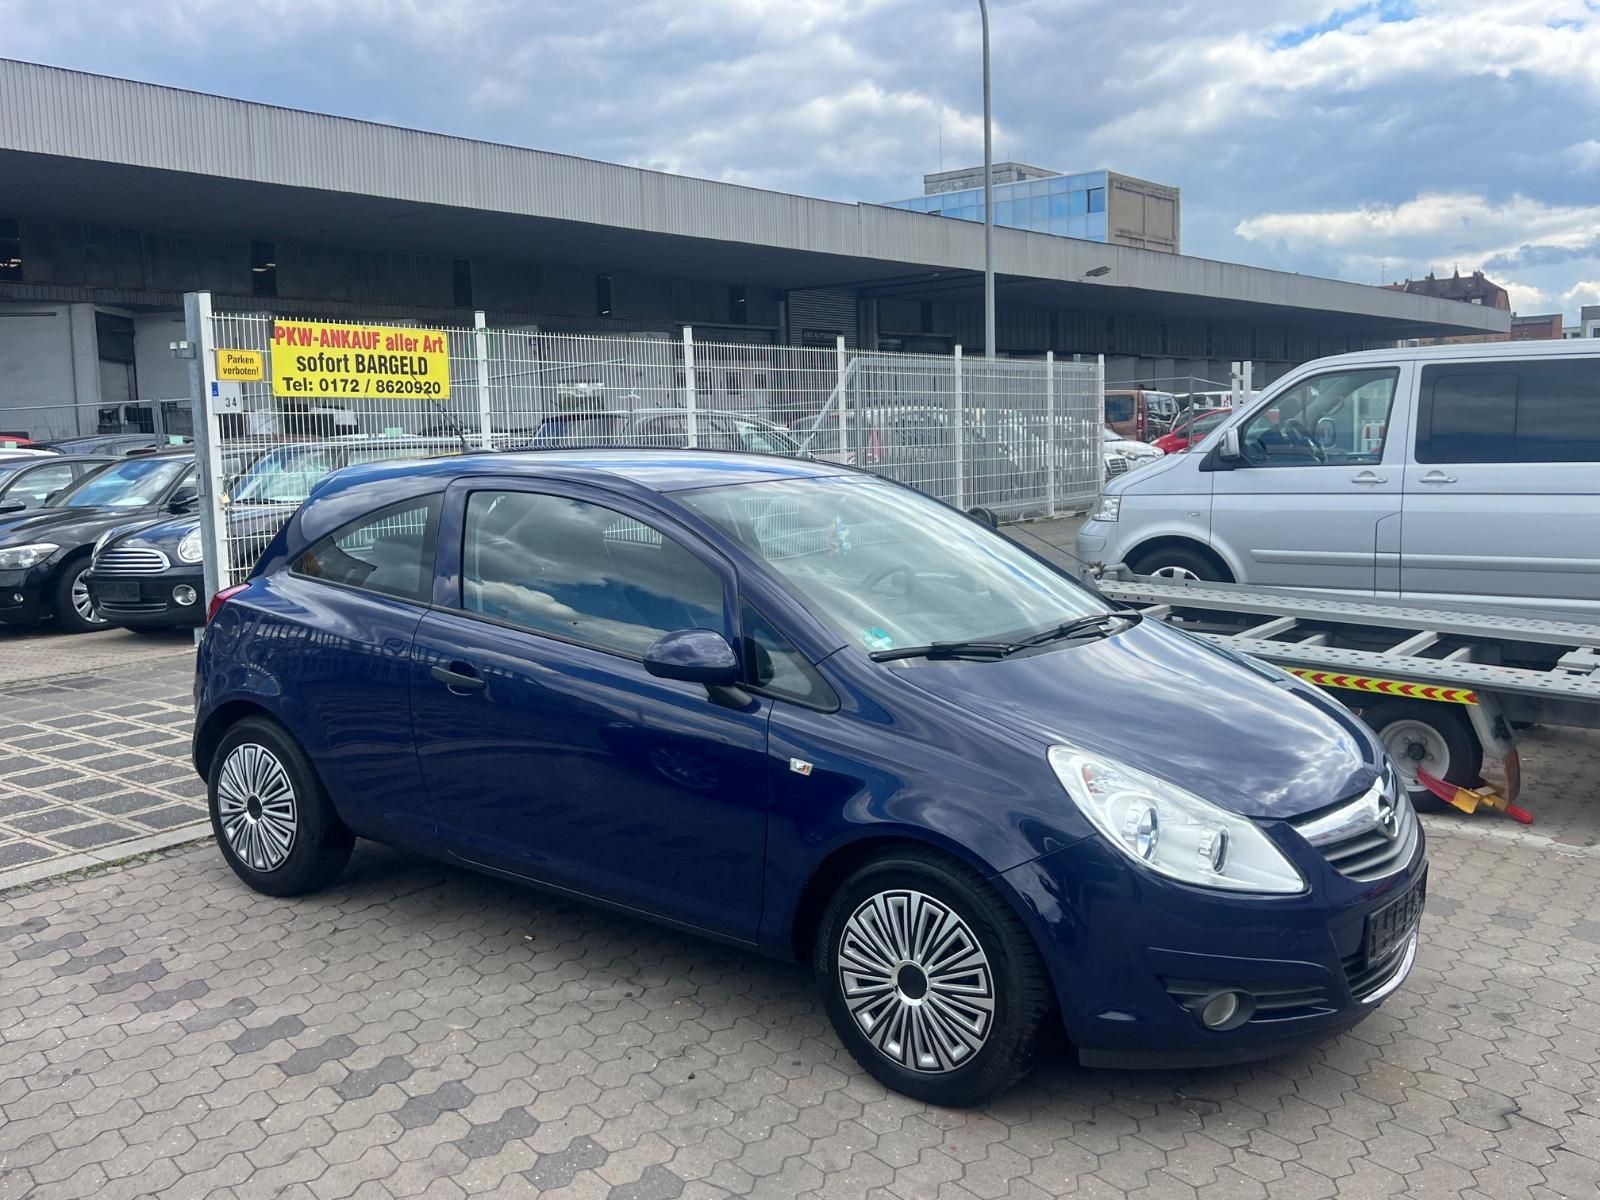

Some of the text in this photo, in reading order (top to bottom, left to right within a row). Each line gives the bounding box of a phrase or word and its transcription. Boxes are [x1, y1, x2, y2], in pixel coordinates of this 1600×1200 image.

[274, 326, 444, 353] PKW-ANKAUF aller Art
[227, 354, 254, 365] Parken
[296, 352, 428, 376] sofort BARGELD
[222, 366, 259, 376] verboten!
[282, 376, 441, 395] Tel: 0172 / 8620920
[225, 397, 237, 408] 34
